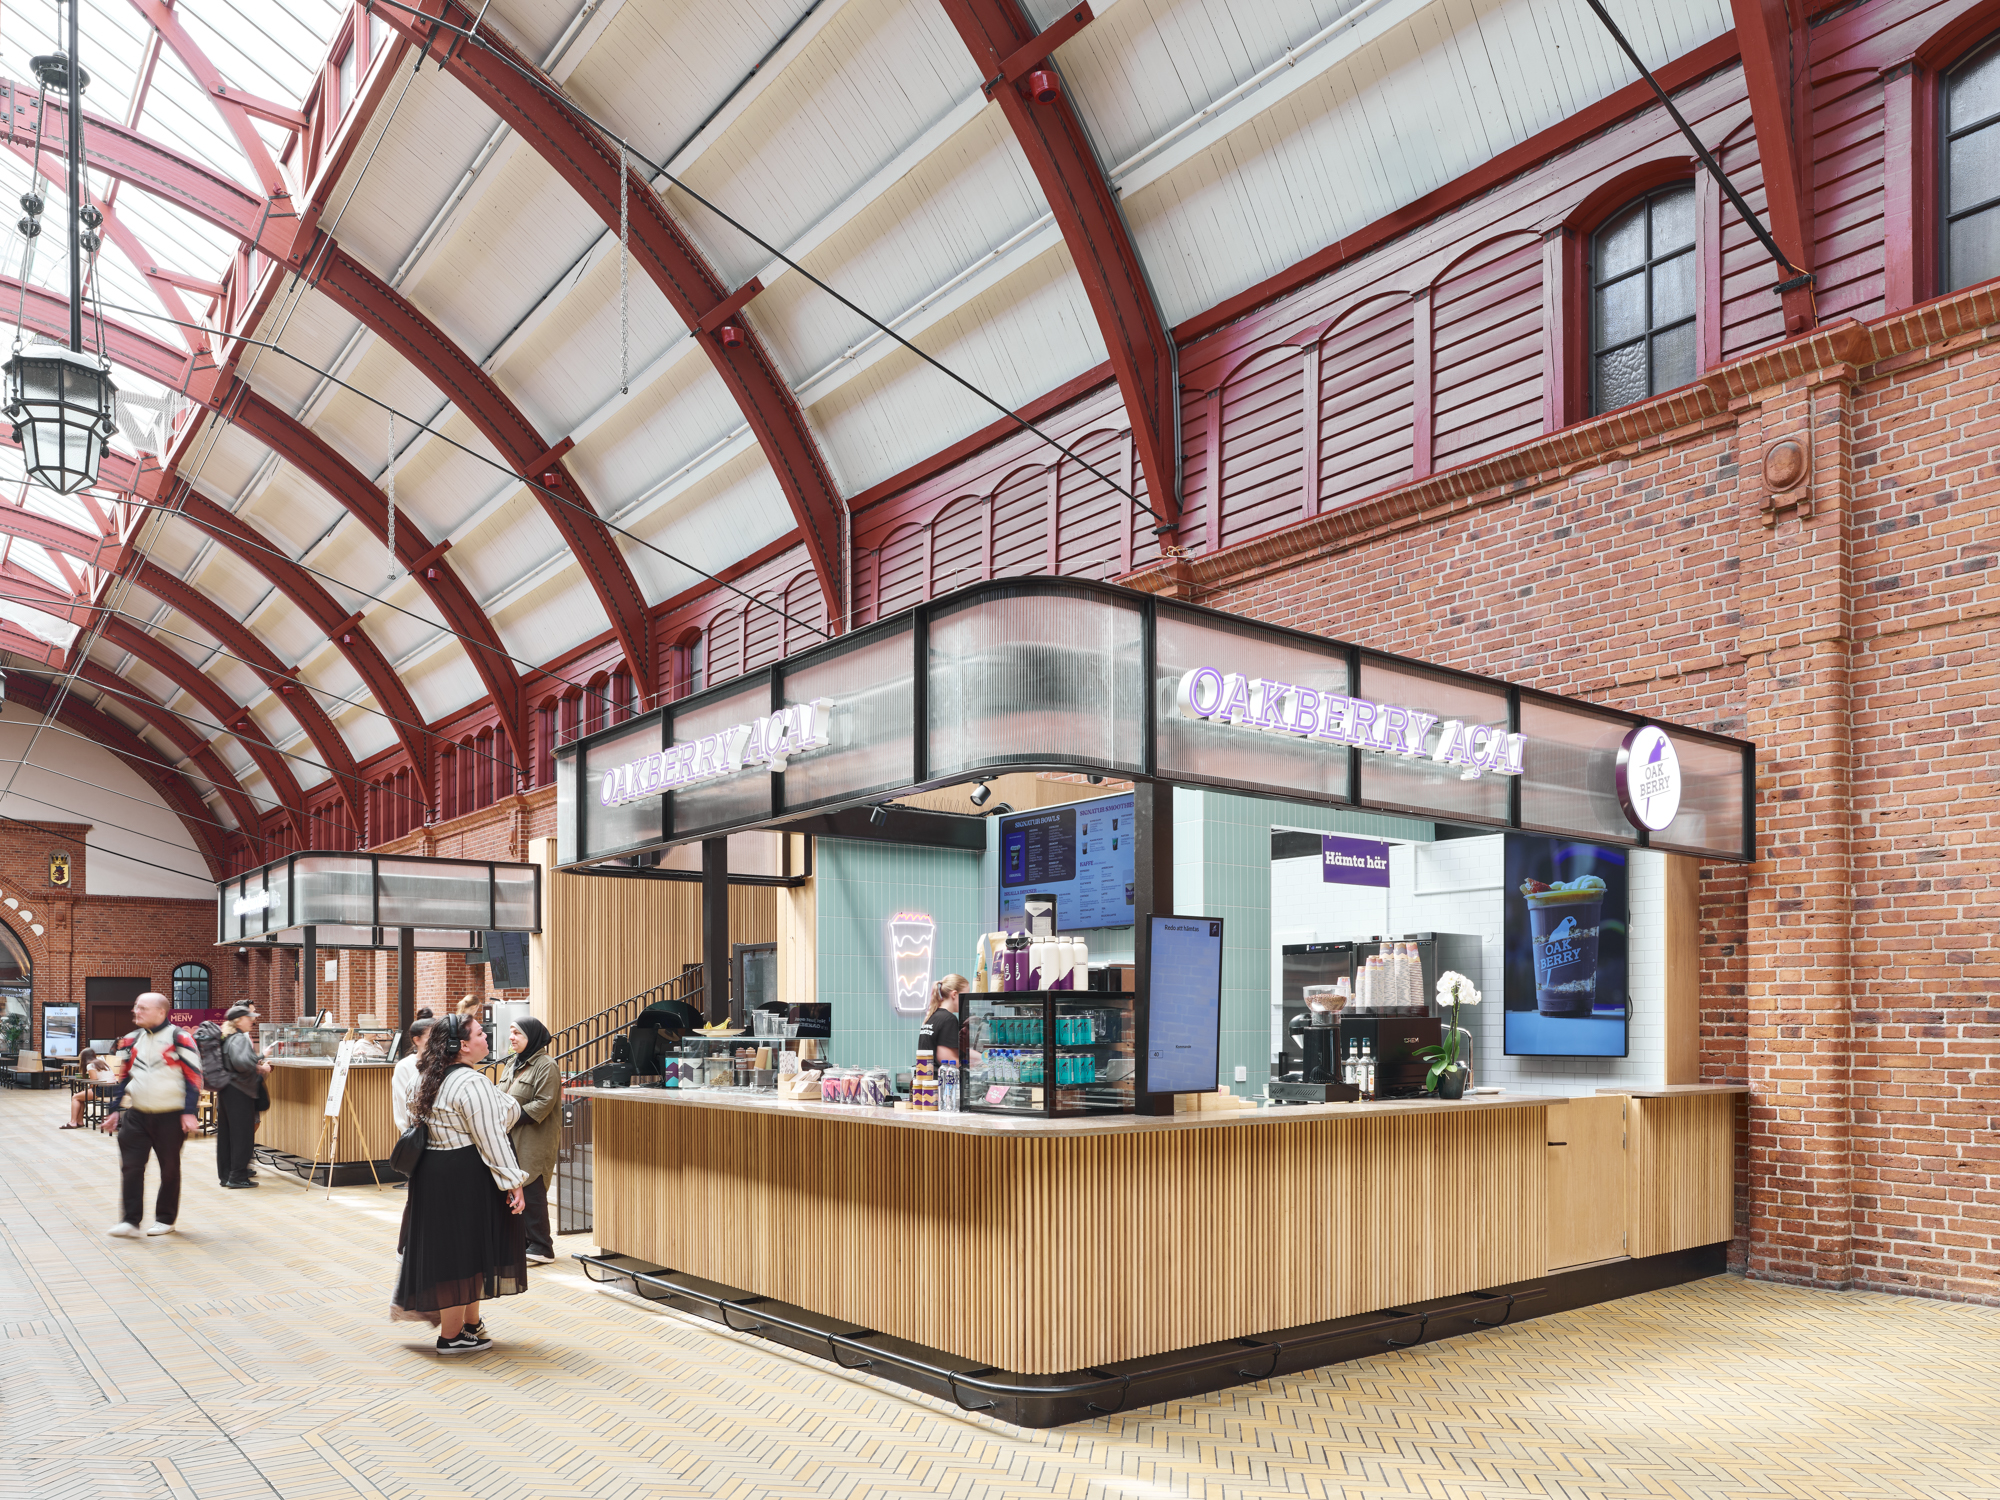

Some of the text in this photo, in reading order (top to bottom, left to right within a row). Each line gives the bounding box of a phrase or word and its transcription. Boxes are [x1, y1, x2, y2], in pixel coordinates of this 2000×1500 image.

[1180, 665, 1528, 780] OAKBERRY AÇAI
[600, 697, 831, 808] OAKBERRY AÇAI
[1645, 763, 1664, 780] OAK
[1640, 775, 1671, 797] BERRY
[1041, 815, 1061, 824] BOWLS
[1325, 850, 1387, 870] Hämta här
[1545, 938, 1572, 956] OAK
[1540, 948, 1581, 970] BERRY
[170, 1014, 193, 1022] MENY
